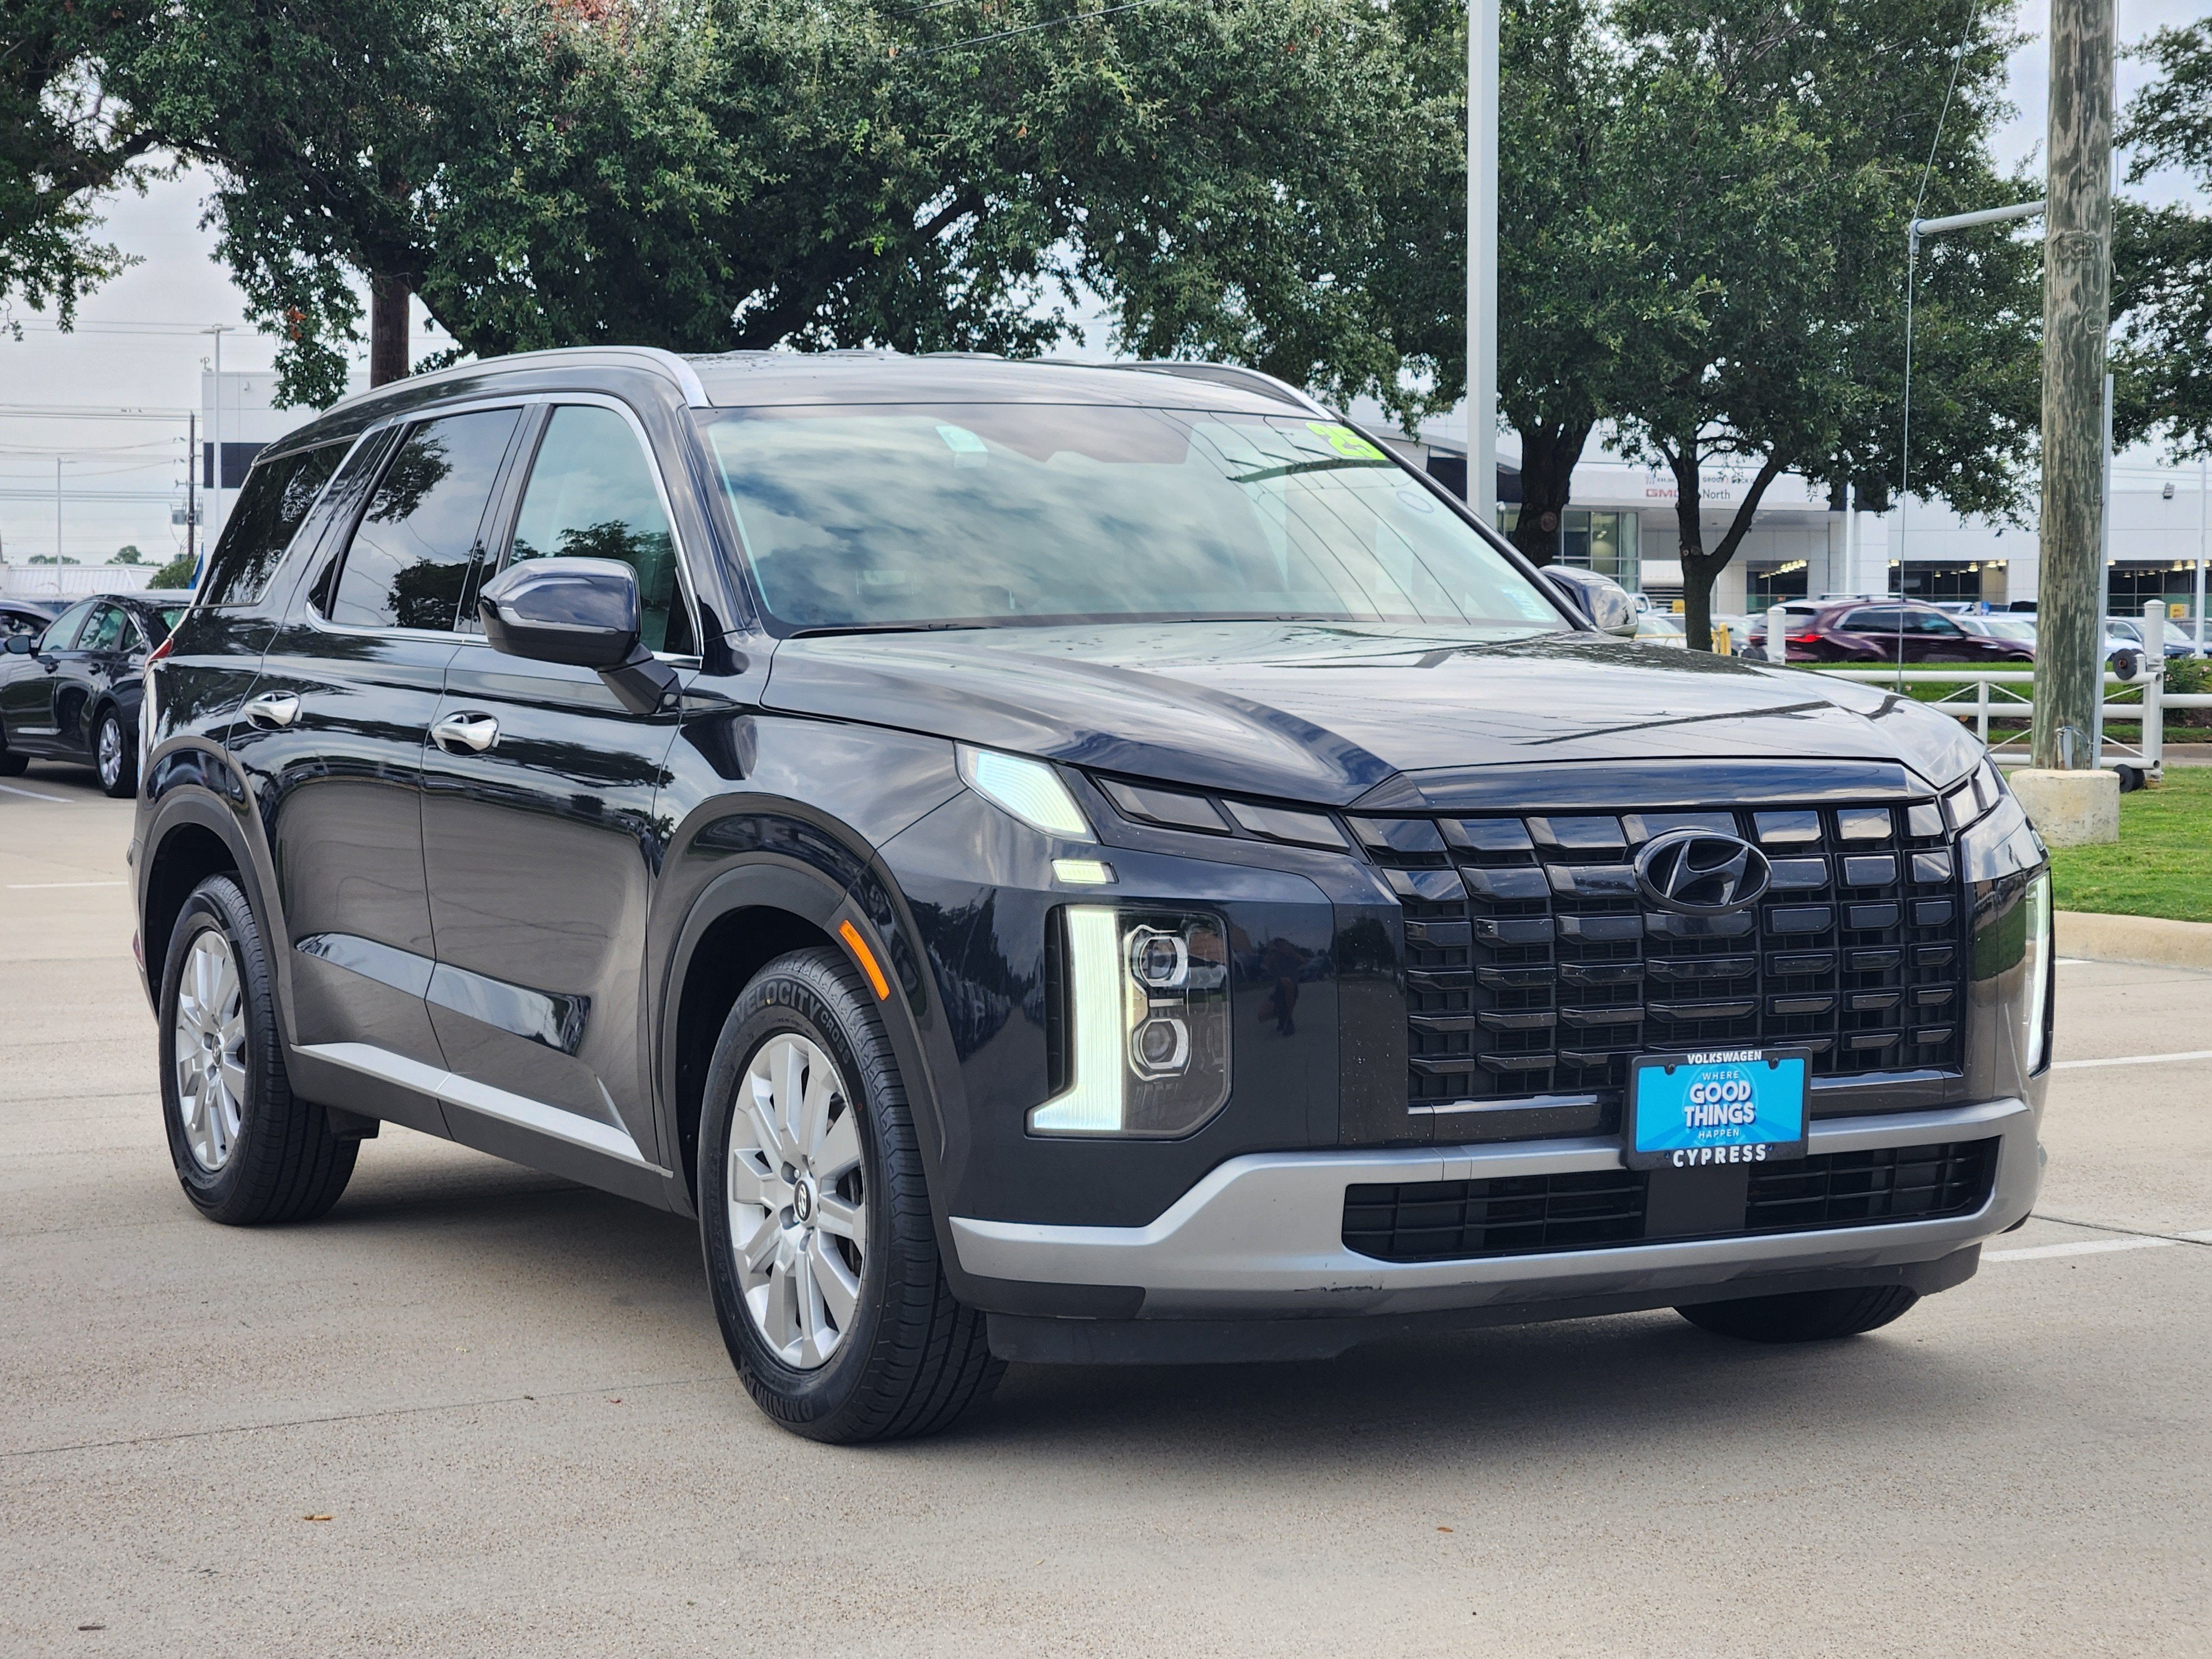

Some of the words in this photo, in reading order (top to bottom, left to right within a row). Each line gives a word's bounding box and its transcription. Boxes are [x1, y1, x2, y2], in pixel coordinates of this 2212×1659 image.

[1703, 489, 1730, 499] North
[735, 981, 822, 1022] VELOCITY
[820, 1010, 852, 1064] CROSS
[1687, 1050, 1762, 1065] VOLKSWAGEN
[1702, 1070, 1740, 1080] WHERE
[1689, 1081, 1752, 1104] GOOD
[1684, 1104, 1756, 1128] THINGS
[1698, 1128, 1740, 1140] HAPPEN
[1672, 1144, 1767, 1168] CYPRESS
